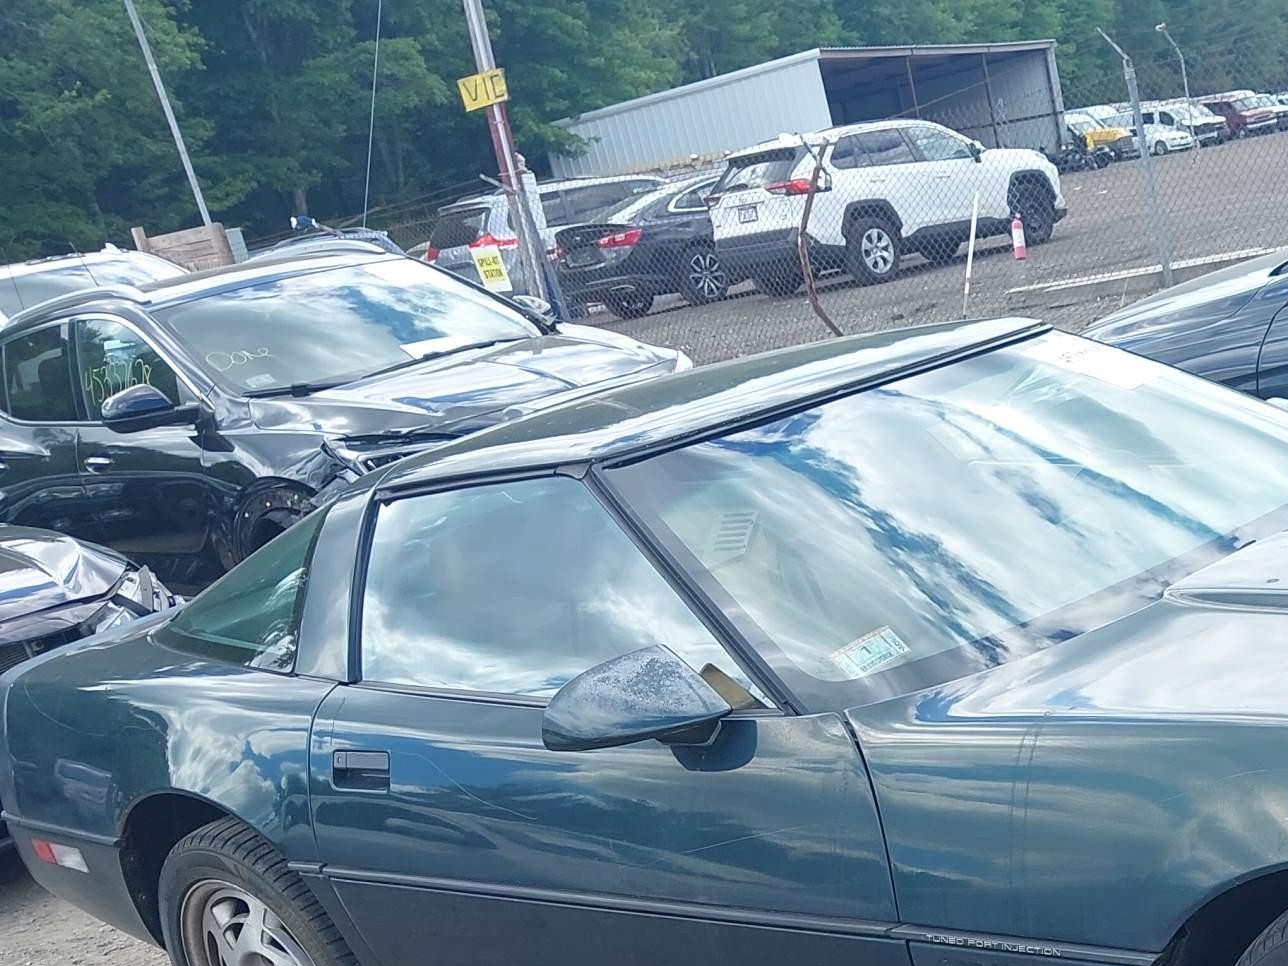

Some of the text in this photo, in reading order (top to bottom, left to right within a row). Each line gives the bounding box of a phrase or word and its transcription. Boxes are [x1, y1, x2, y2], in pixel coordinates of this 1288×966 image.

[926, 934, 1062, 957] TUNED PORT INJECTION
